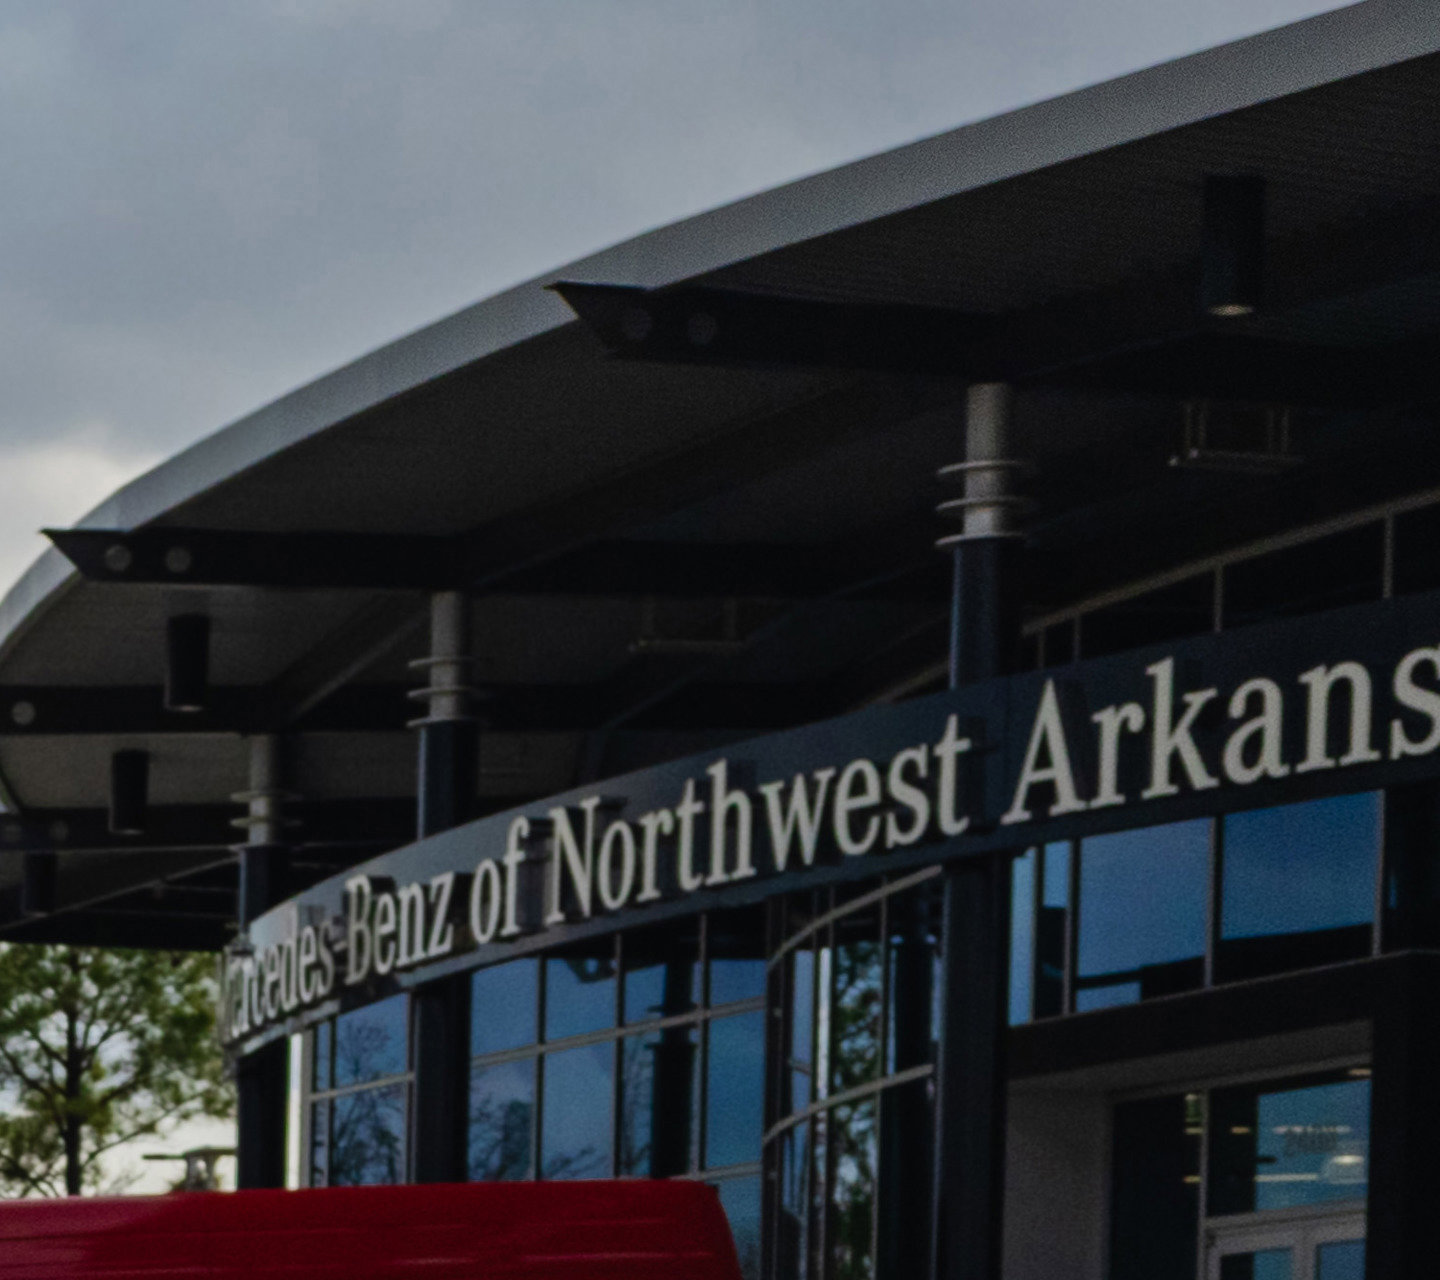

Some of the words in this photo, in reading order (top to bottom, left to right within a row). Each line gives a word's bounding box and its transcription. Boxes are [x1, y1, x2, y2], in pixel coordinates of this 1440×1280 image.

[220, 872, 455, 1042] rcedes-Benz
[470, 818, 529, 945] of
[543, 714, 971, 926] Northwest
[999, 643, 1440, 824] Arkans
